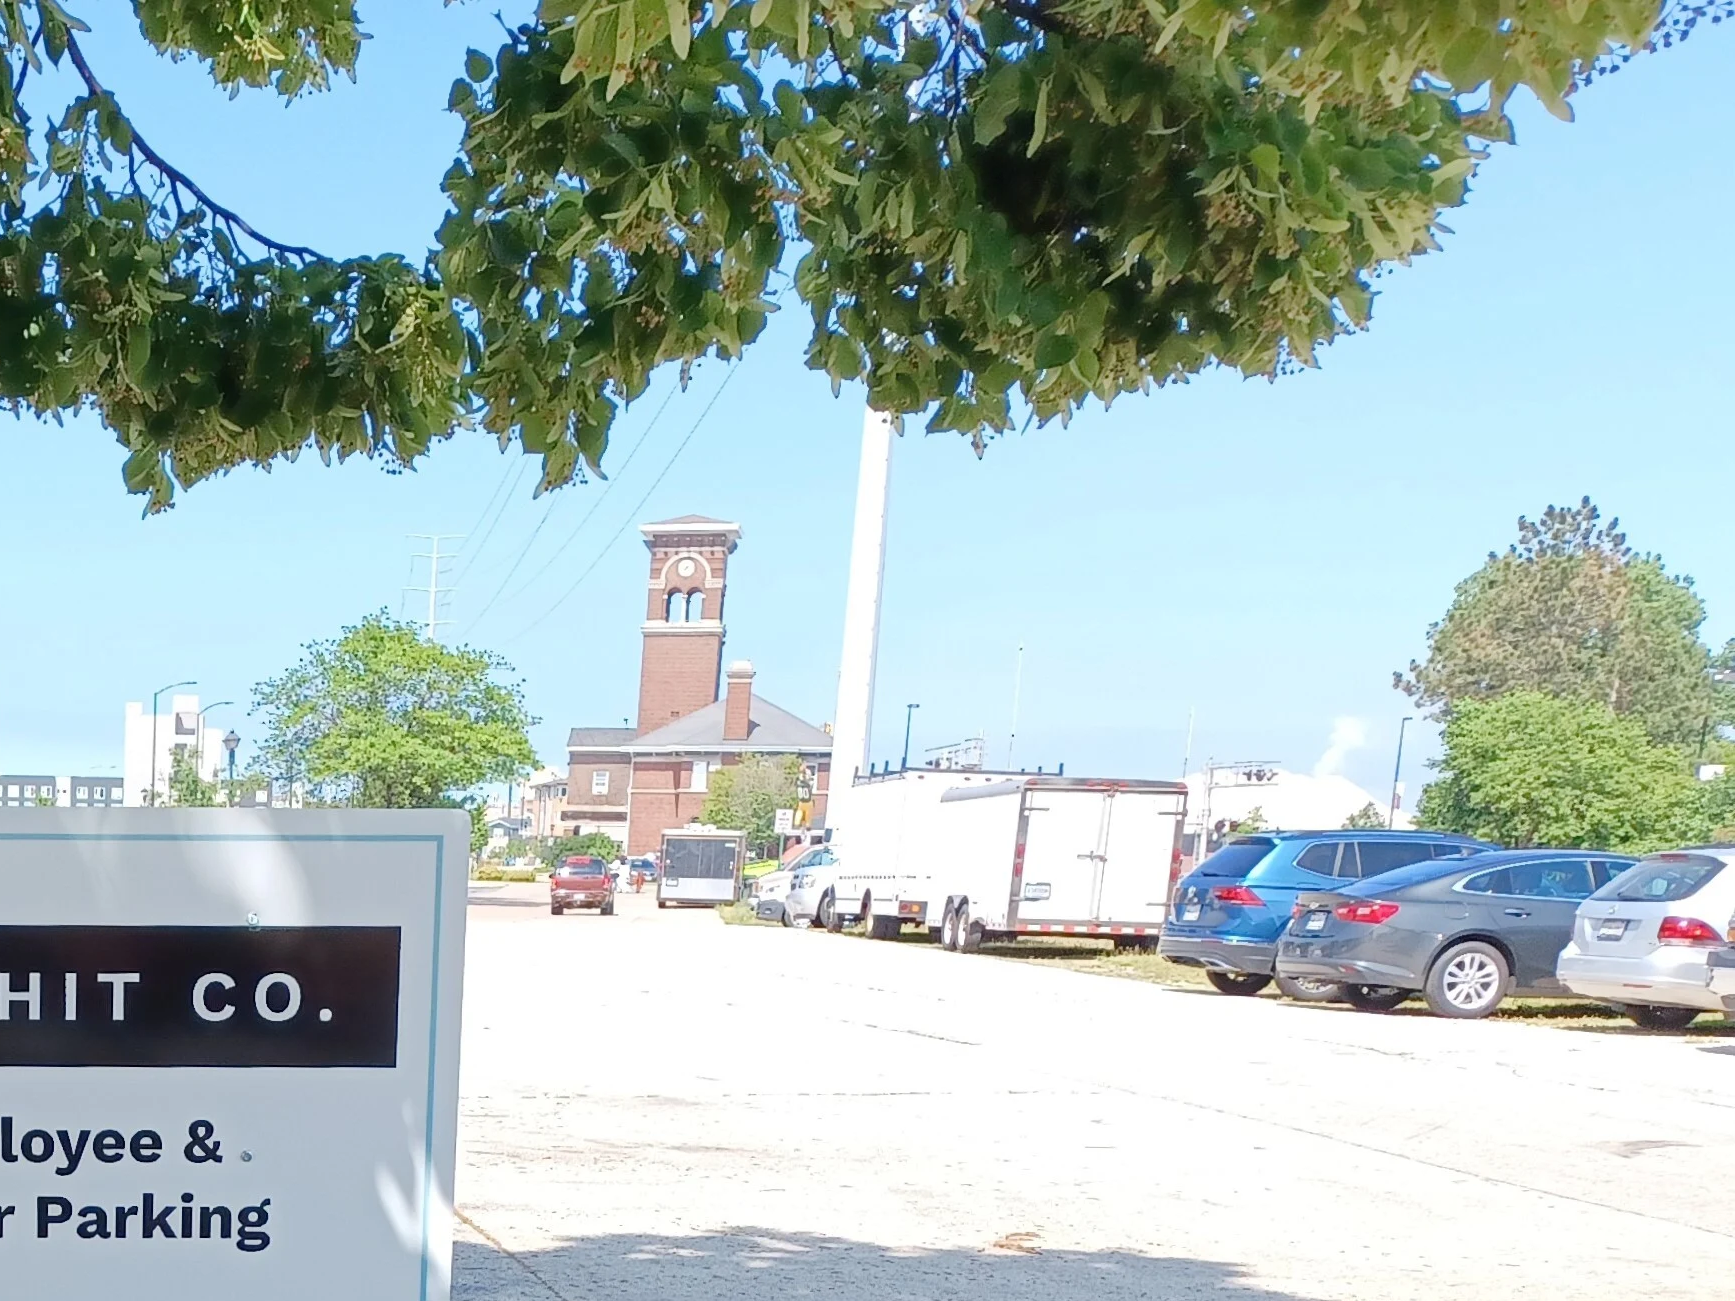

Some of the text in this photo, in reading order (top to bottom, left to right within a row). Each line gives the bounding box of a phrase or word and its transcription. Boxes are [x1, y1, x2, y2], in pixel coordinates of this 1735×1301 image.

[192, 972, 333, 1022] CO.
[183, 1119, 224, 1164] &
[37, 1192, 271, 1252] Parking
